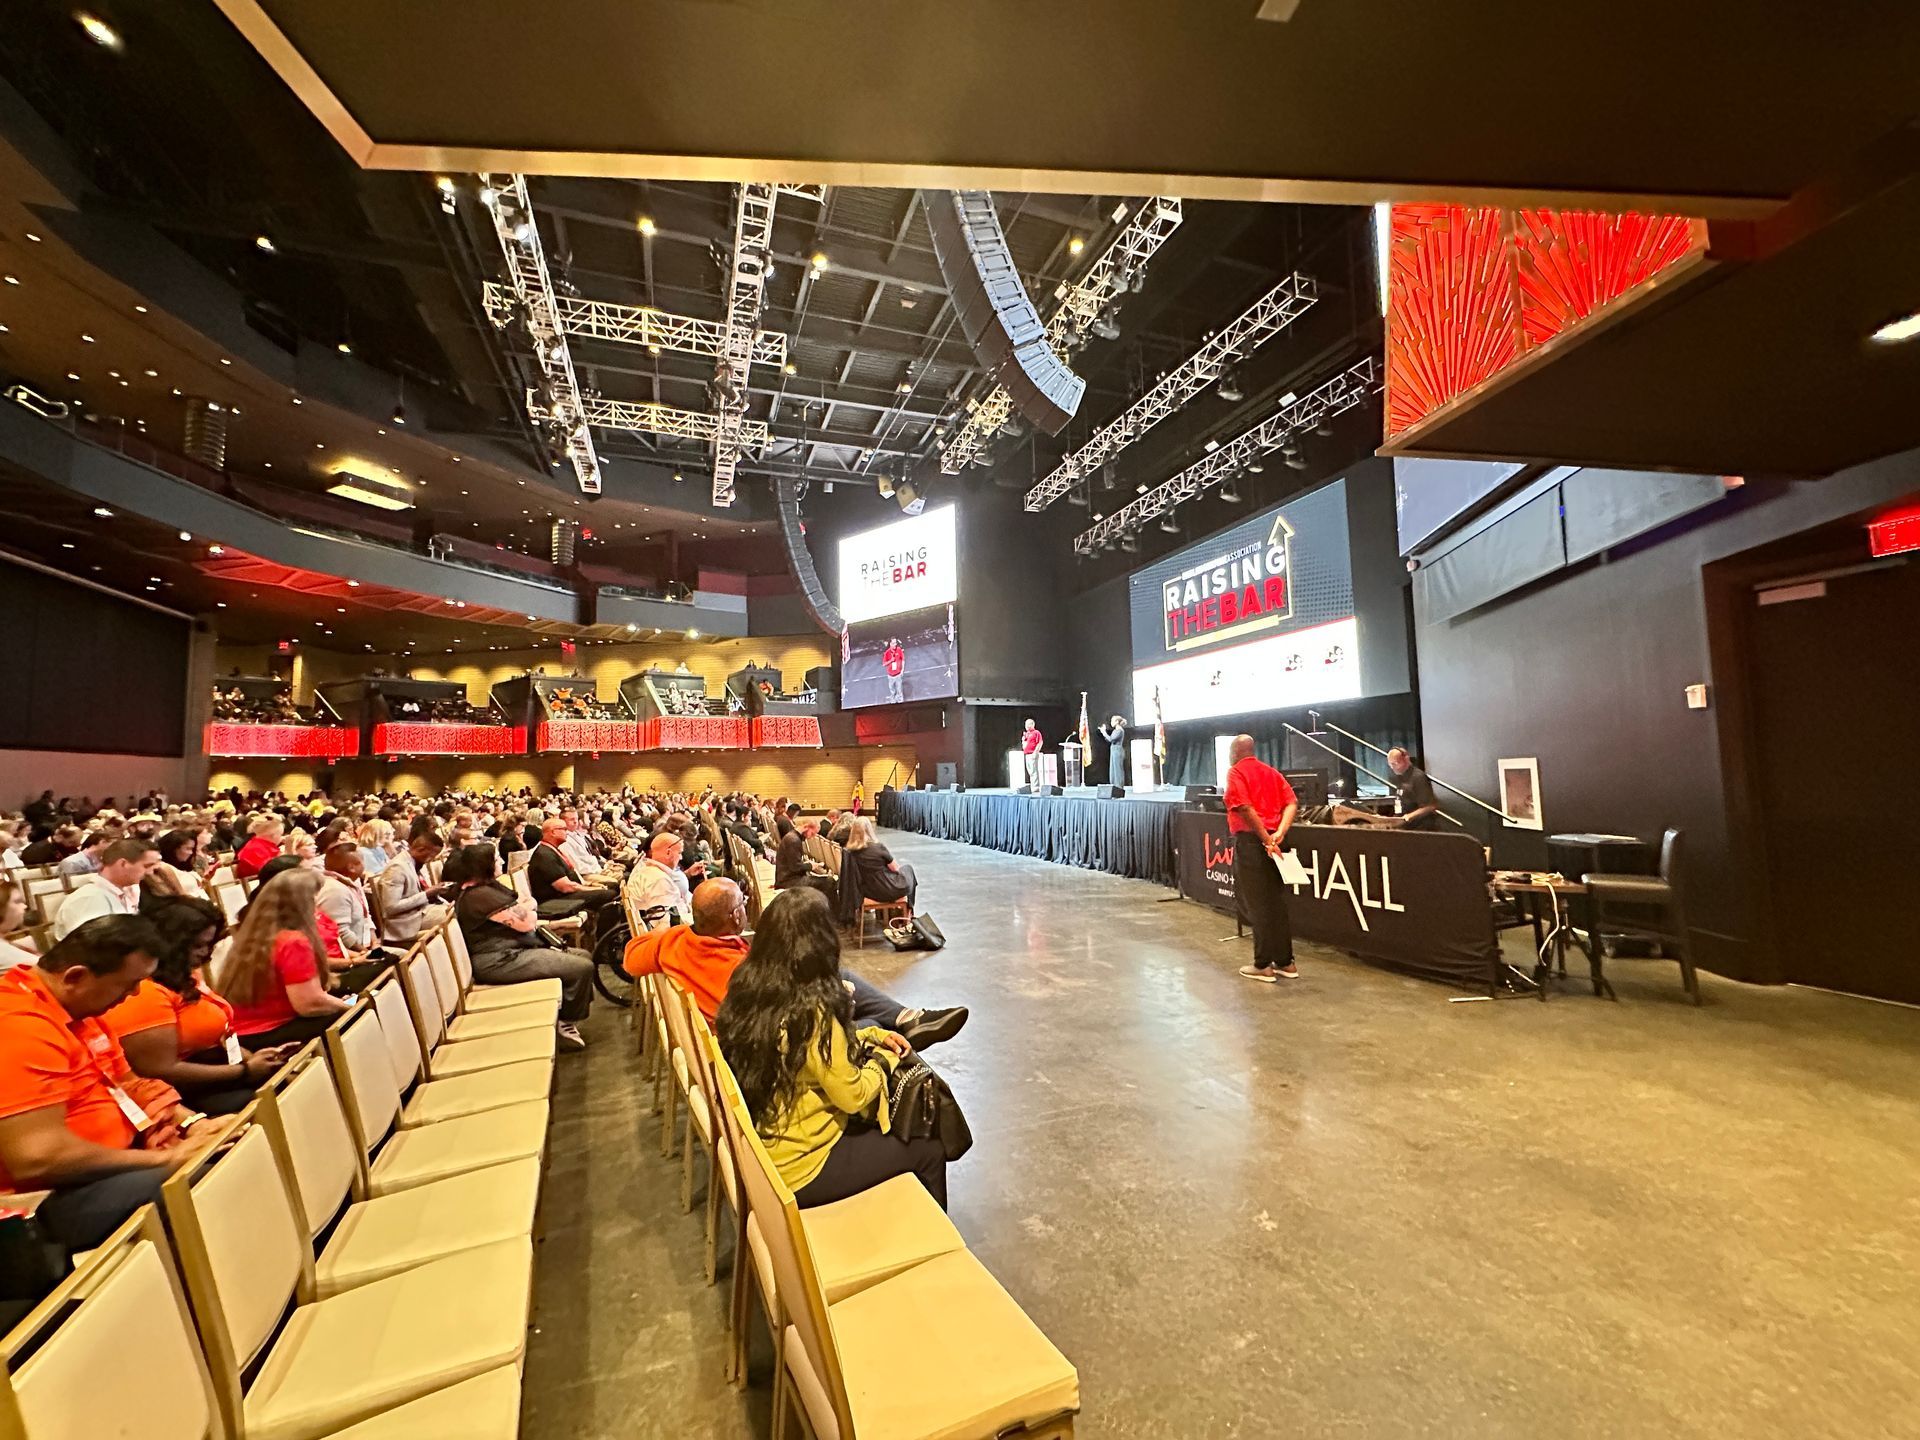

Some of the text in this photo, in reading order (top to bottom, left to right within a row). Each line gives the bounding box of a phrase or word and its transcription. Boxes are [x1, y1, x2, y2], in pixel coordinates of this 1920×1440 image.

[861, 546, 927, 575] RAISING
[893, 561, 927, 584] BAR
[1166, 545, 1286, 611] RAISING
[1168, 575, 1286, 638] THE BAR
[1204, 832, 1234, 869] Liv
[1206, 869, 1229, 884] CASINO
[1290, 847, 1405, 932] HALL
